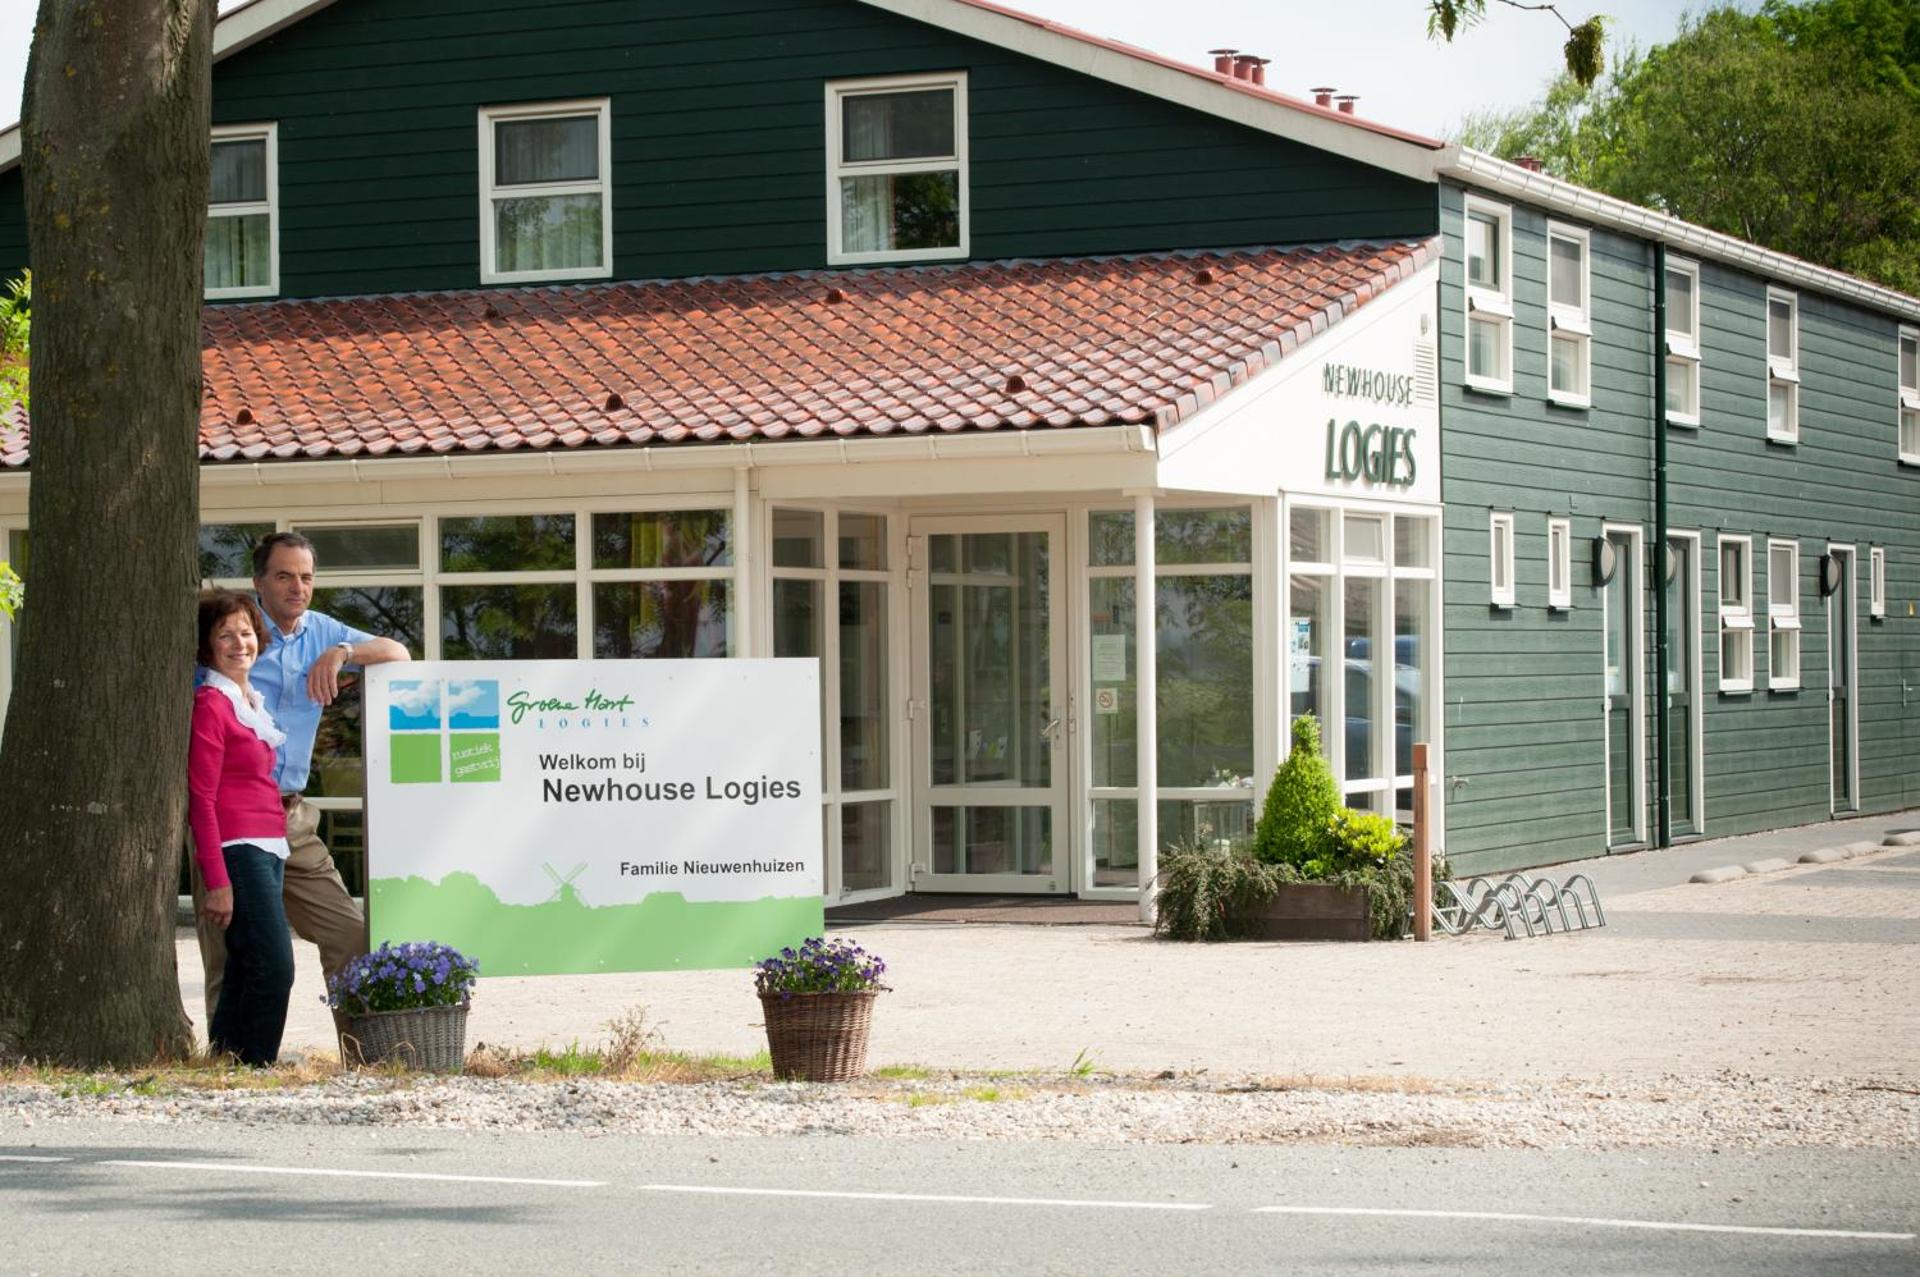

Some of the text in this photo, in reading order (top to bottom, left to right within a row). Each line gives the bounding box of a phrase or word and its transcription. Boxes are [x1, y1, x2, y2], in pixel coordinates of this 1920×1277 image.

[1322, 362, 1415, 406] NEWHOUSE
[1324, 418, 1417, 487] LOGIES
[506, 688, 635, 725] Groene Hart
[538, 717, 650, 729] LOGIES
[539, 753, 646, 774] Welkom bij
[542, 775, 802, 806] Newhouse Logies
[619, 857, 806, 877] Familie Nieuwenhuizen
